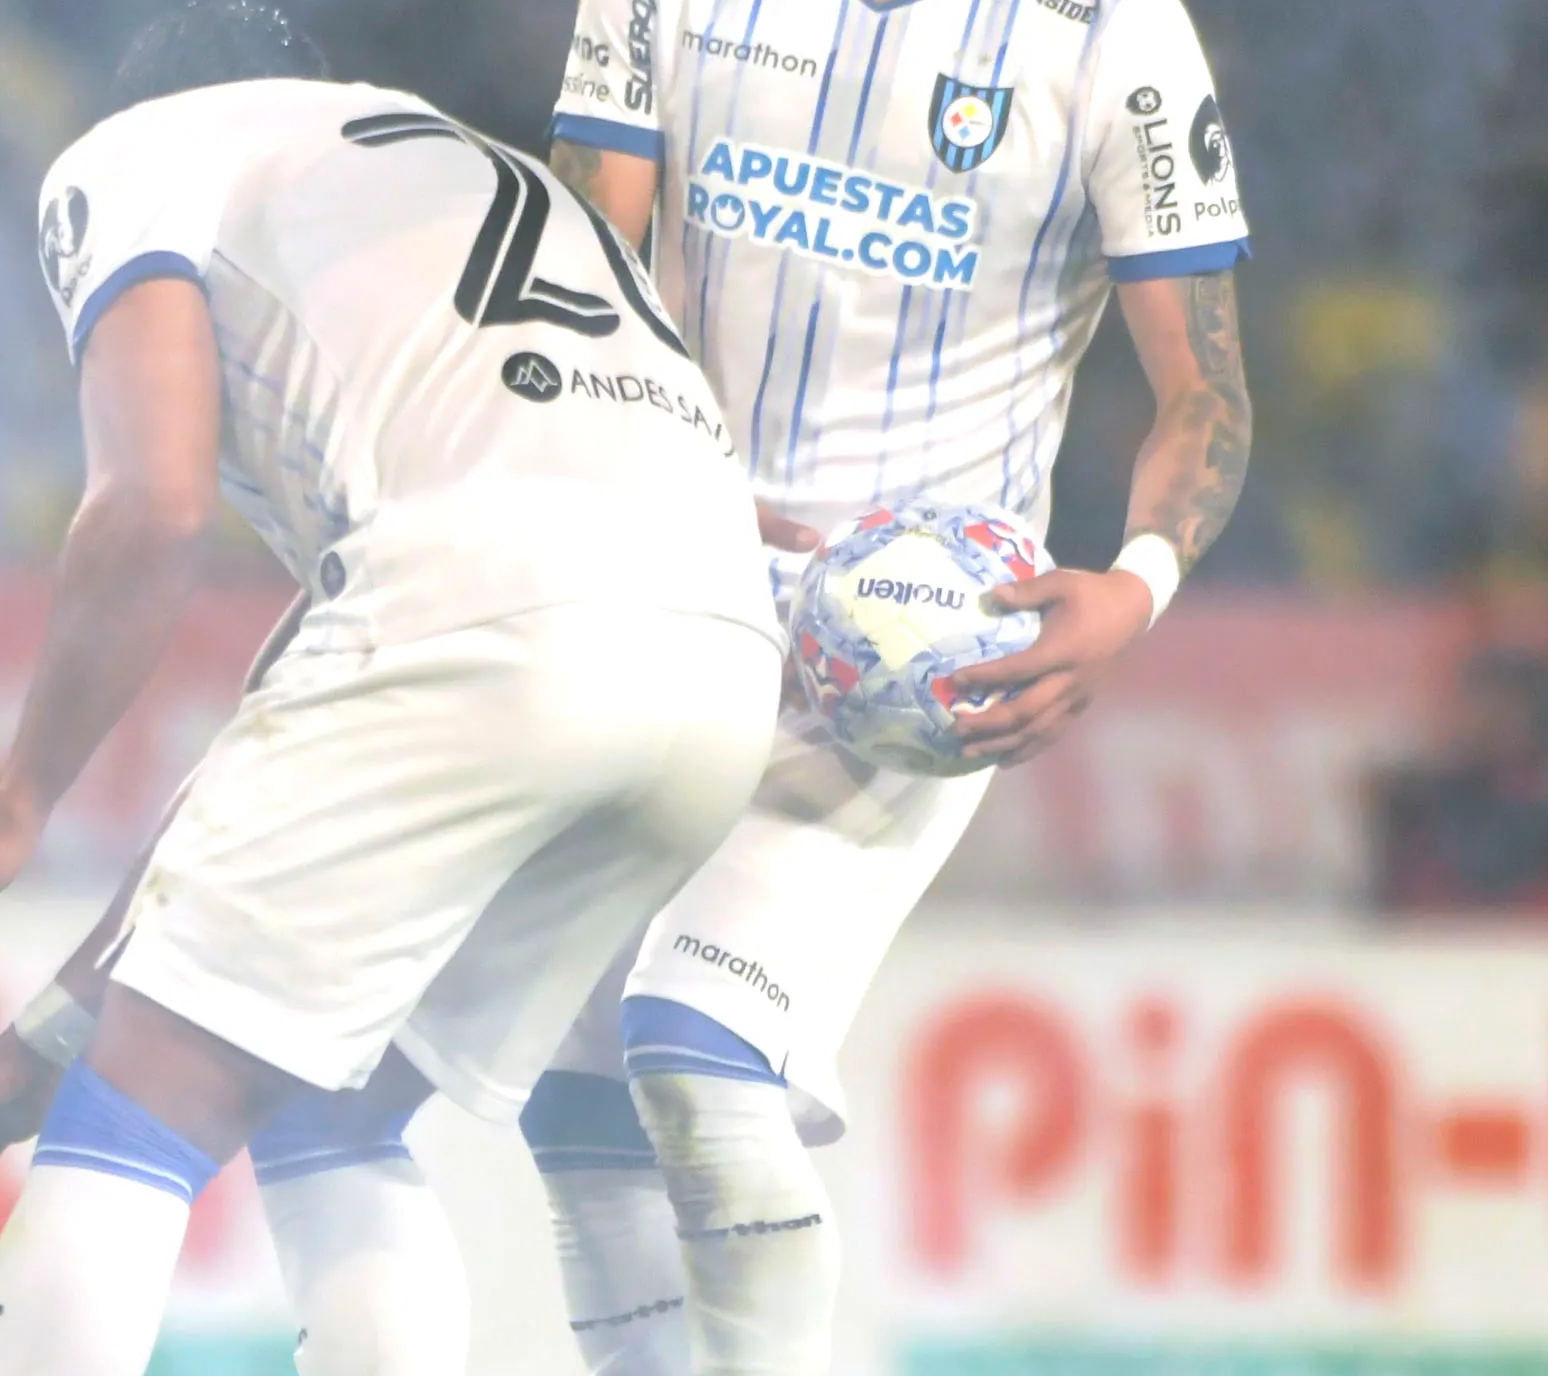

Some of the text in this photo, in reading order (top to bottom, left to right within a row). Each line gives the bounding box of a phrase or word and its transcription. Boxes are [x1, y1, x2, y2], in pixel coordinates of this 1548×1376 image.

[682, 30, 818, 78] marathon
[701, 141, 972, 239] APUESTAS
[1143, 118, 1182, 236] LIONS
[687, 181, 978, 286] ROYAL.COM
[571, 368, 674, 414] ANDES
[856, 577, 966, 611] molten
[672, 933, 791, 1013] marathon
